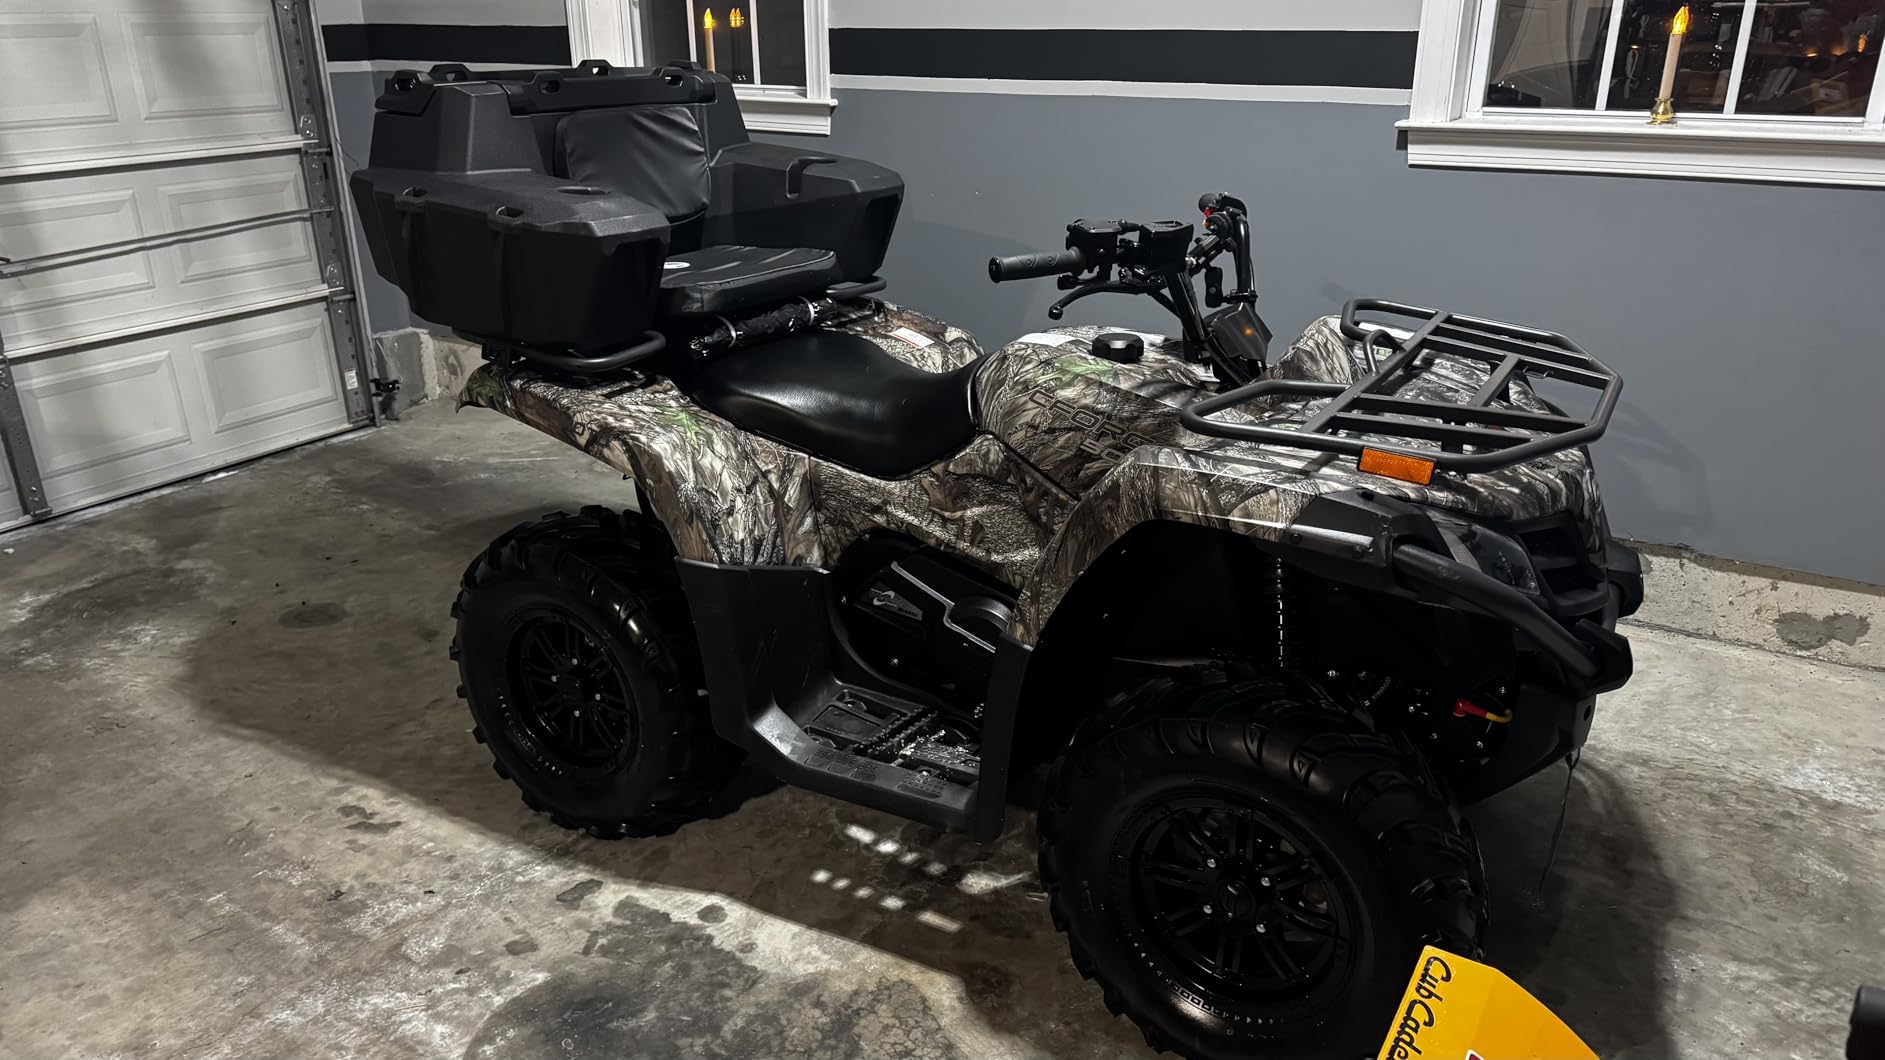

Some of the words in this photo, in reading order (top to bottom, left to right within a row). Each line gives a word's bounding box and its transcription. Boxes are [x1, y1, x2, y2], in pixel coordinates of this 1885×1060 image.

[1029, 389, 1161, 449] CFORC
[1415, 956, 1452, 1002] Cub
[1386, 999, 1435, 1060] Cade
